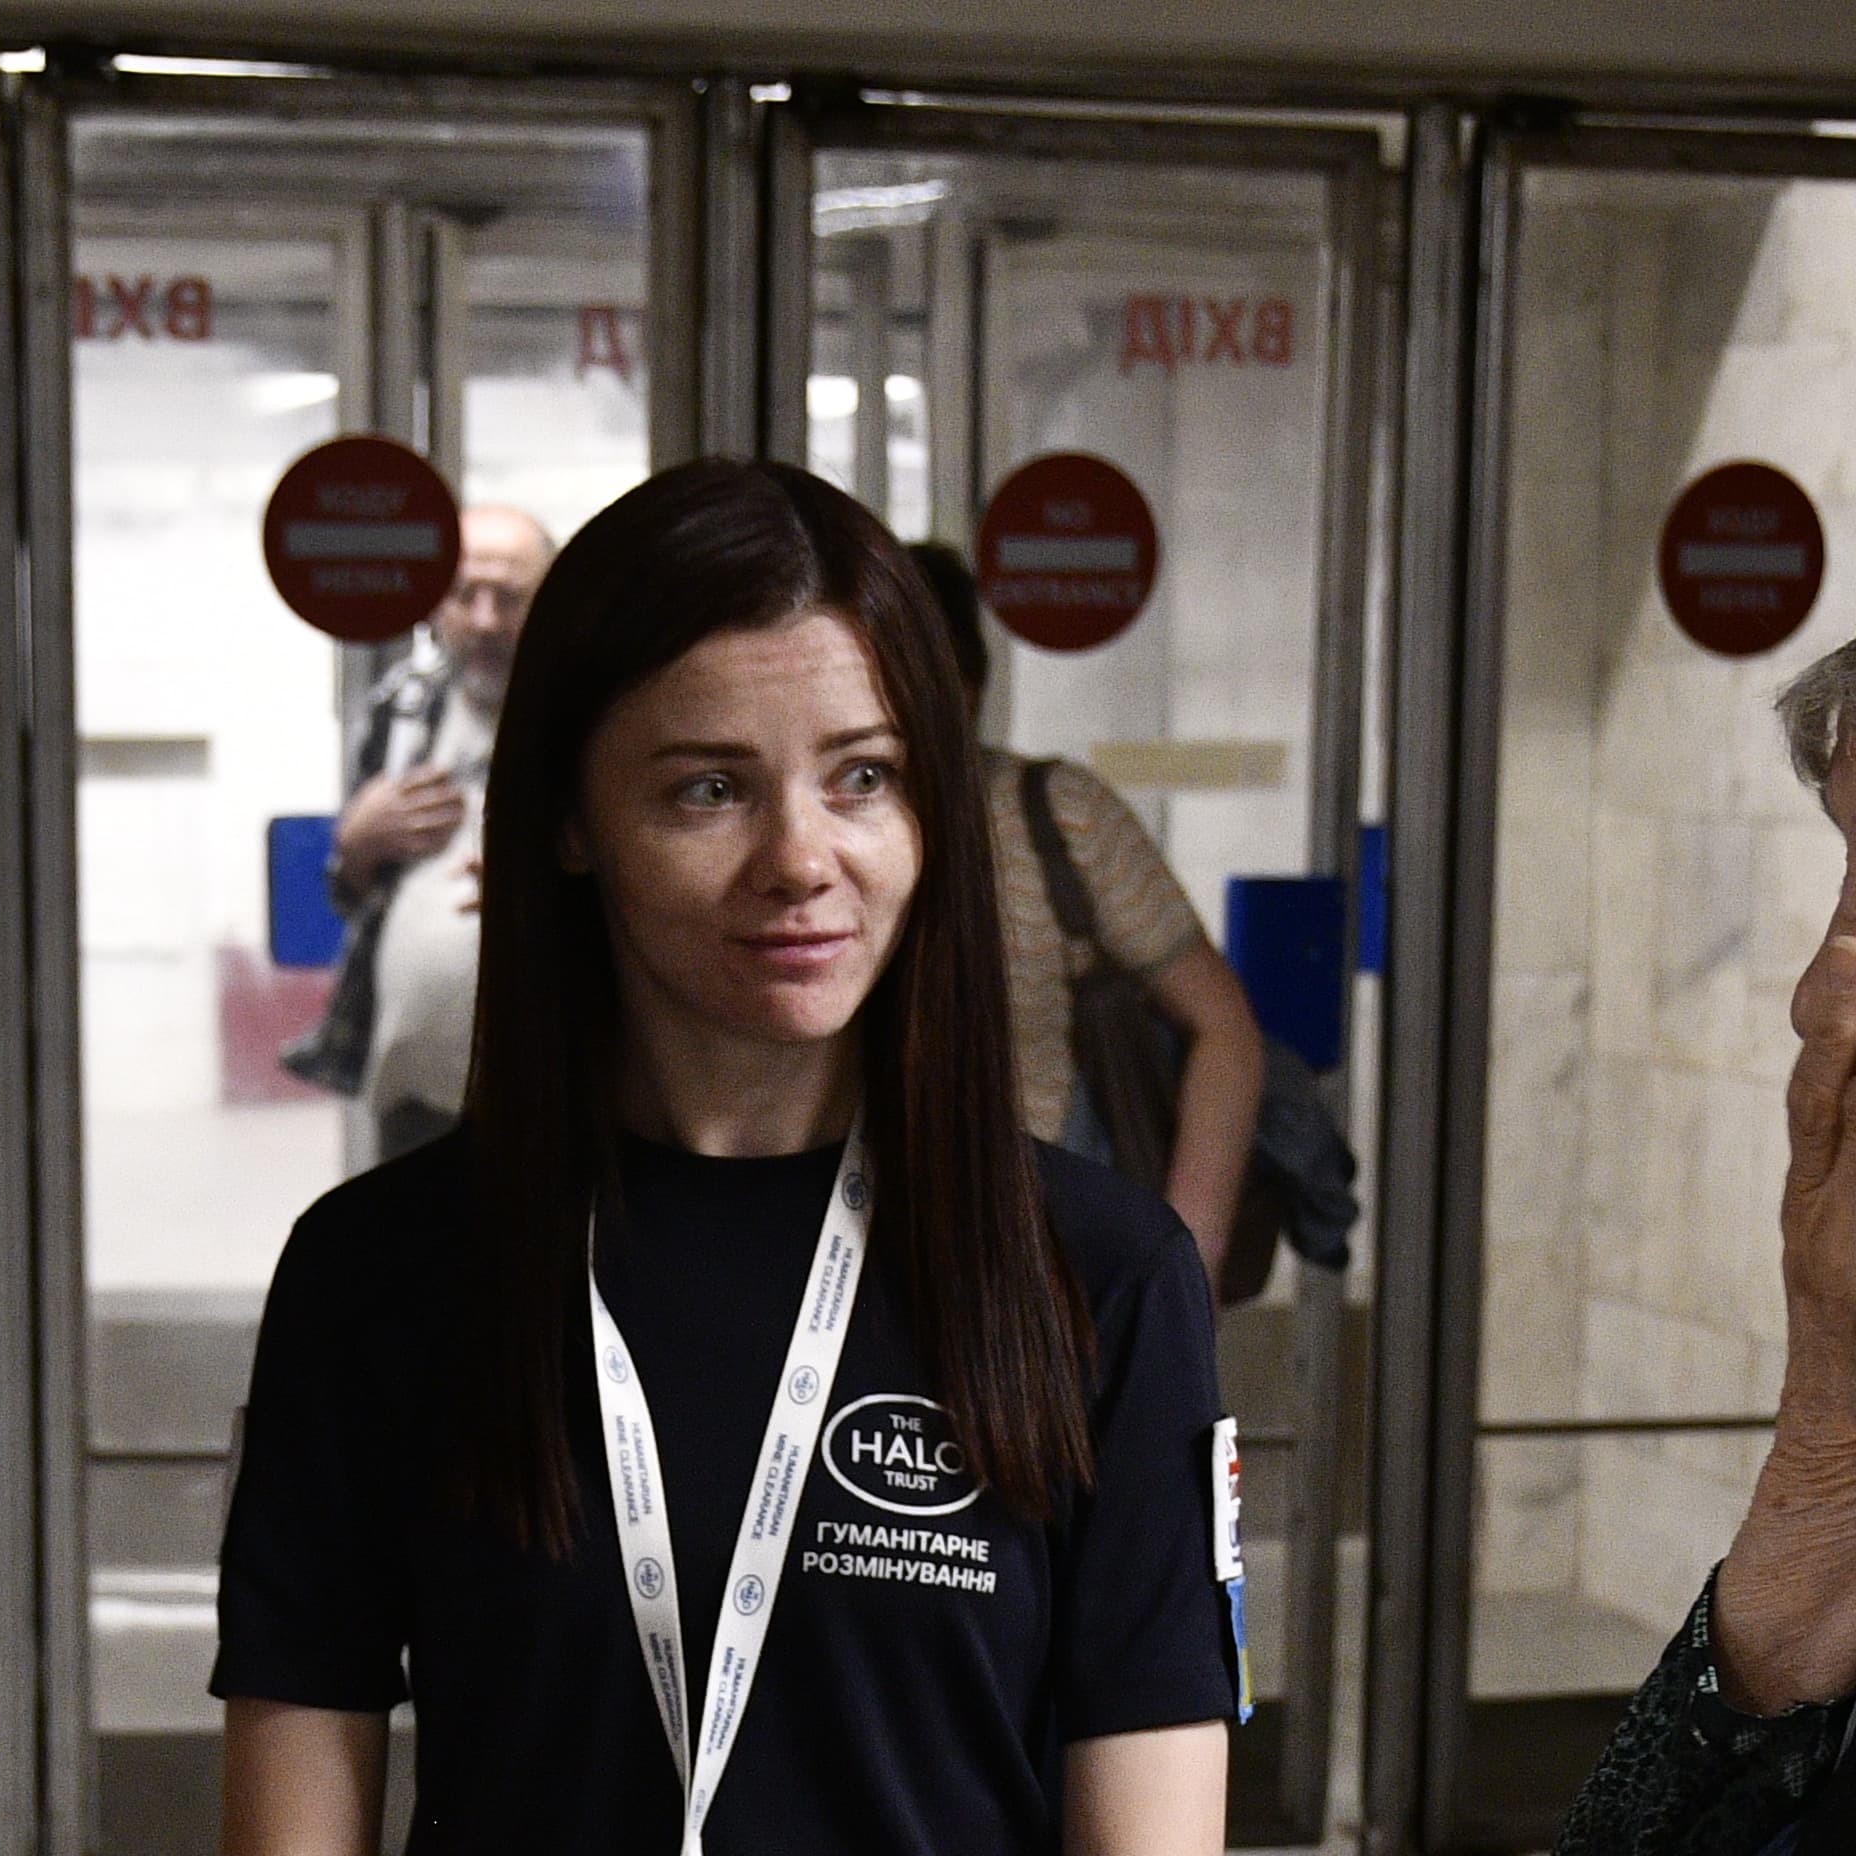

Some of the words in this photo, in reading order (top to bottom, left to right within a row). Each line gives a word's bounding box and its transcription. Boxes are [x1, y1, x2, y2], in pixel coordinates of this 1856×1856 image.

[888, 1413, 924, 1434] THE
[850, 1428, 967, 1475] HALO
[882, 1469, 939, 1492] TRUST
[815, 1520, 991, 1563] ГУМАНІТАРНЕ
[801, 1550, 998, 1595] РОЗМІНУВАННЯ
